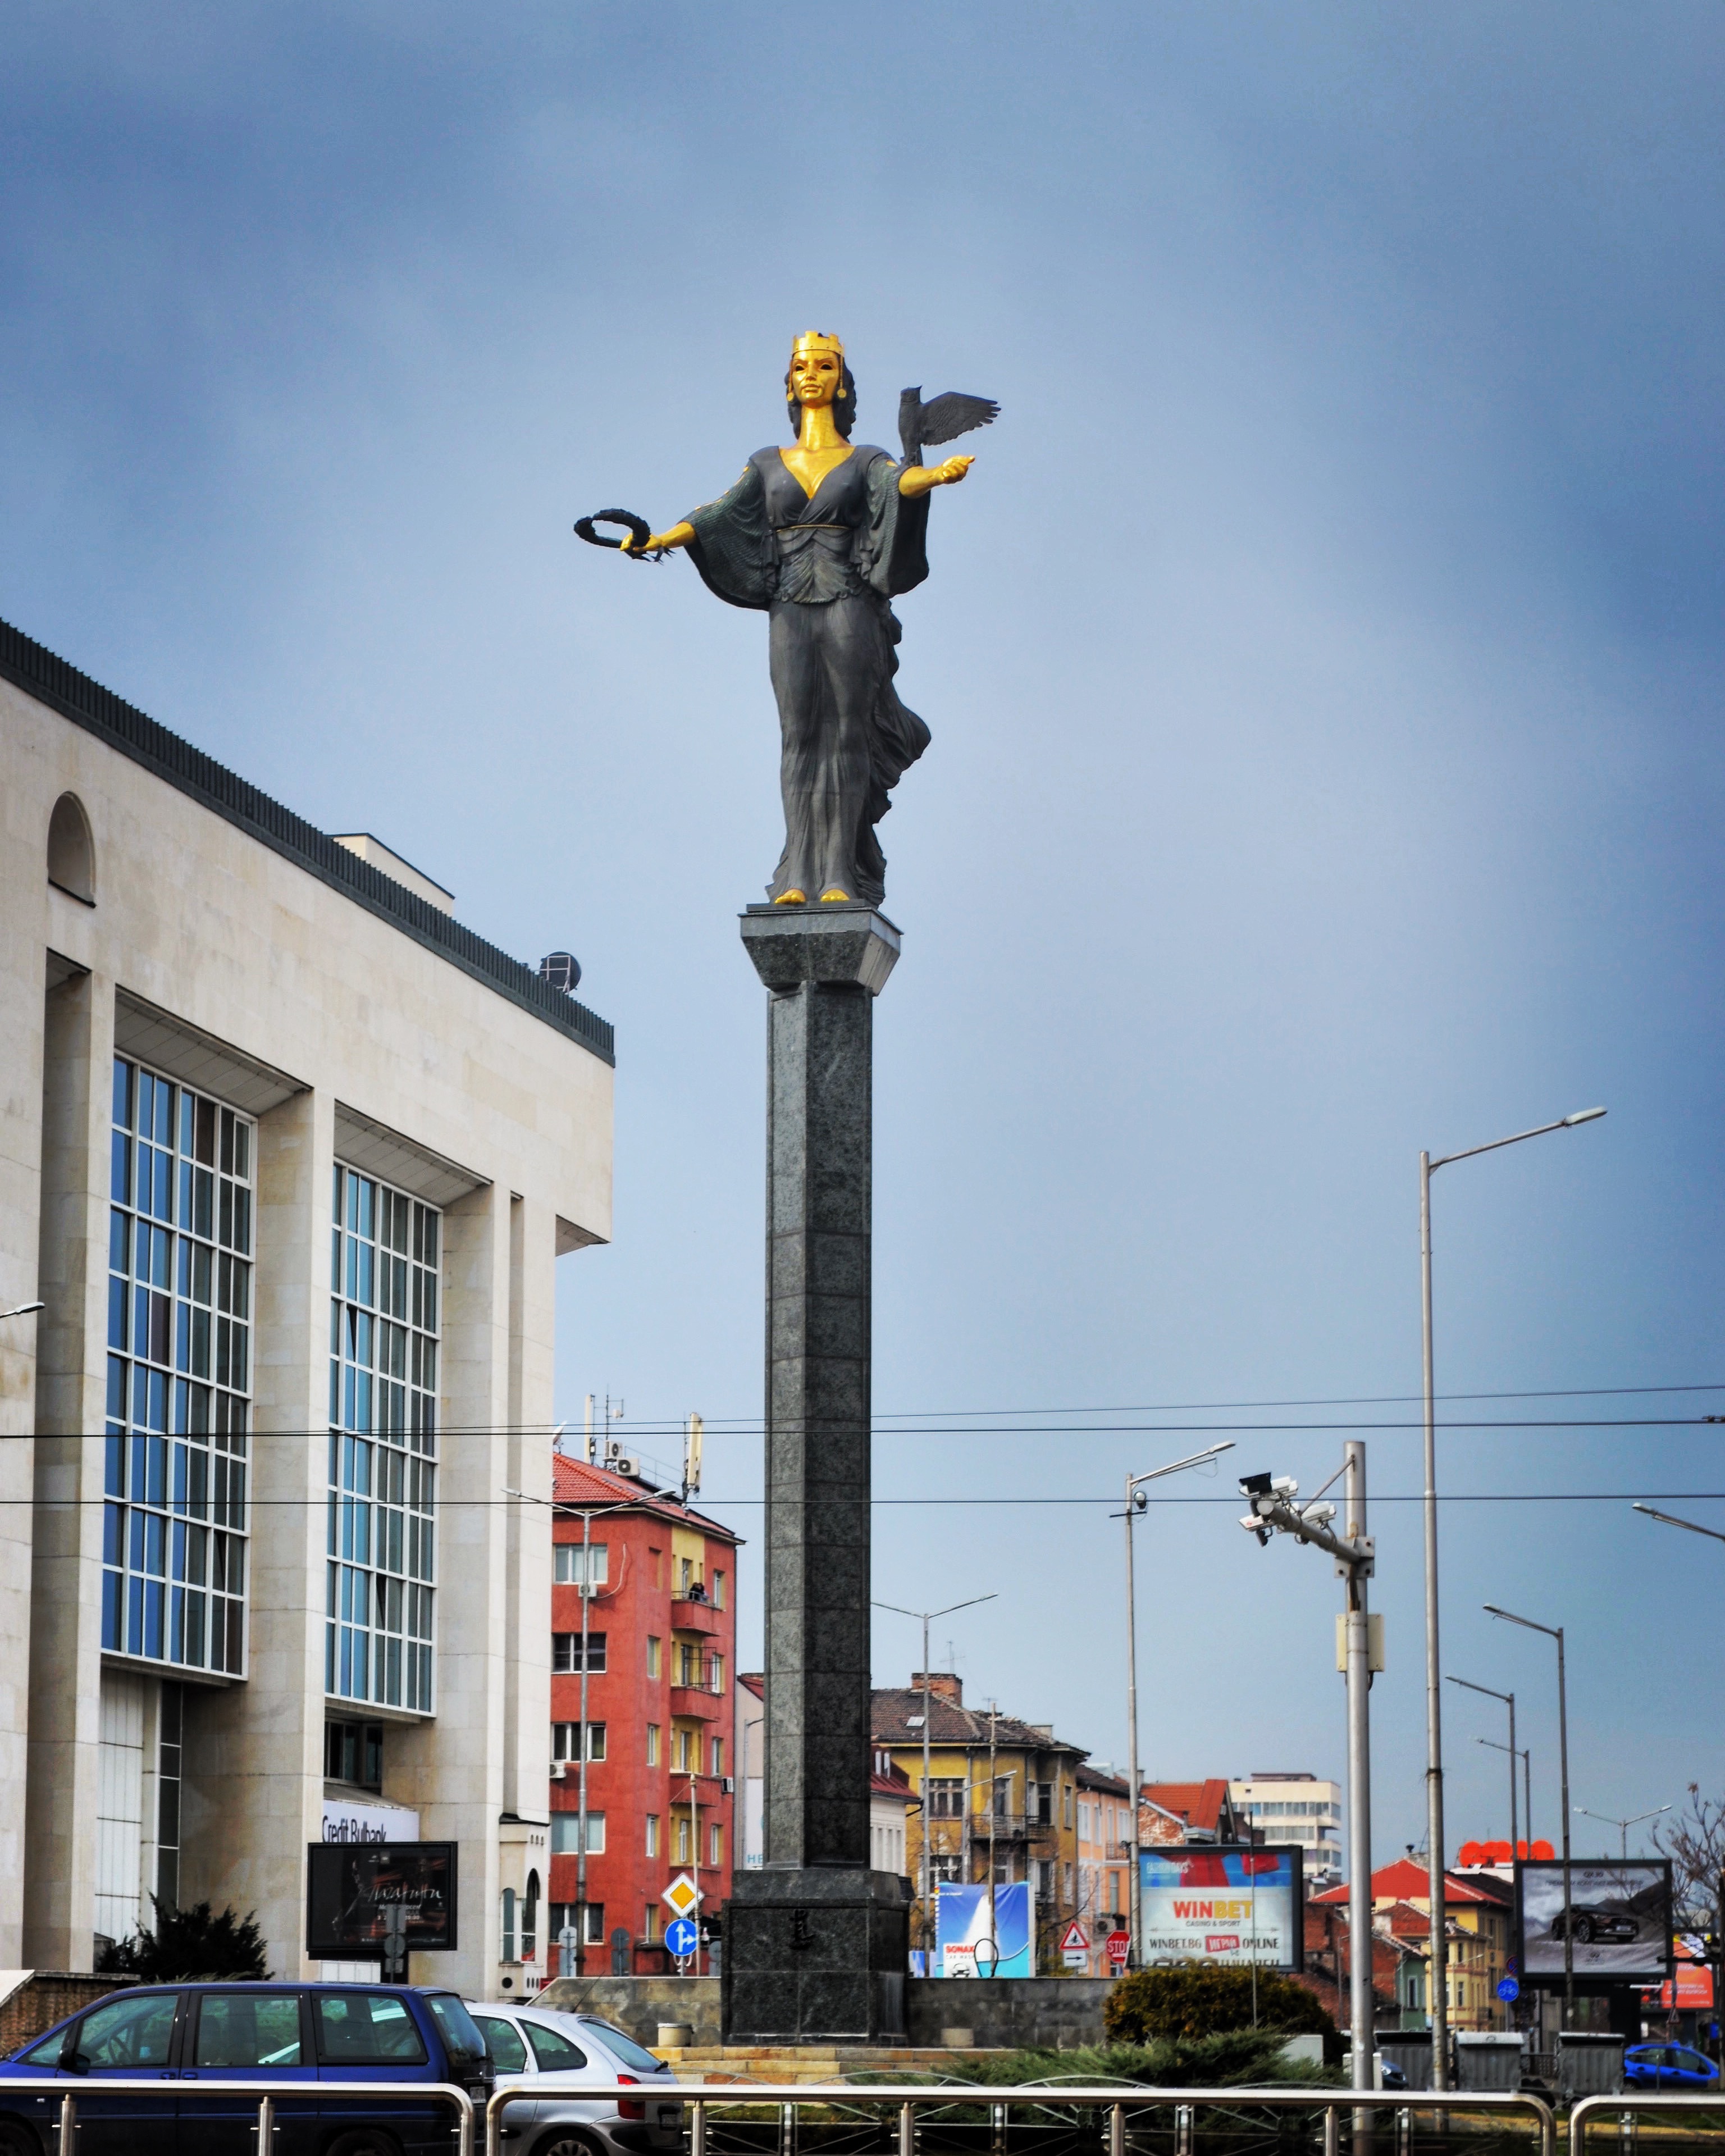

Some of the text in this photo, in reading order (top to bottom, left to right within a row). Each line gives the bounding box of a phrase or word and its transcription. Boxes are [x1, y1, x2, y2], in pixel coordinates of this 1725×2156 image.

[322, 1815, 348, 1842] Credit
[1173, 1900, 1253, 1918] WINBET
[1107, 1940, 1127, 1953] STO
[1149, 1939, 1202, 1949] WINBET.BG
[1243, 1938, 1280, 1949] ONLINE
